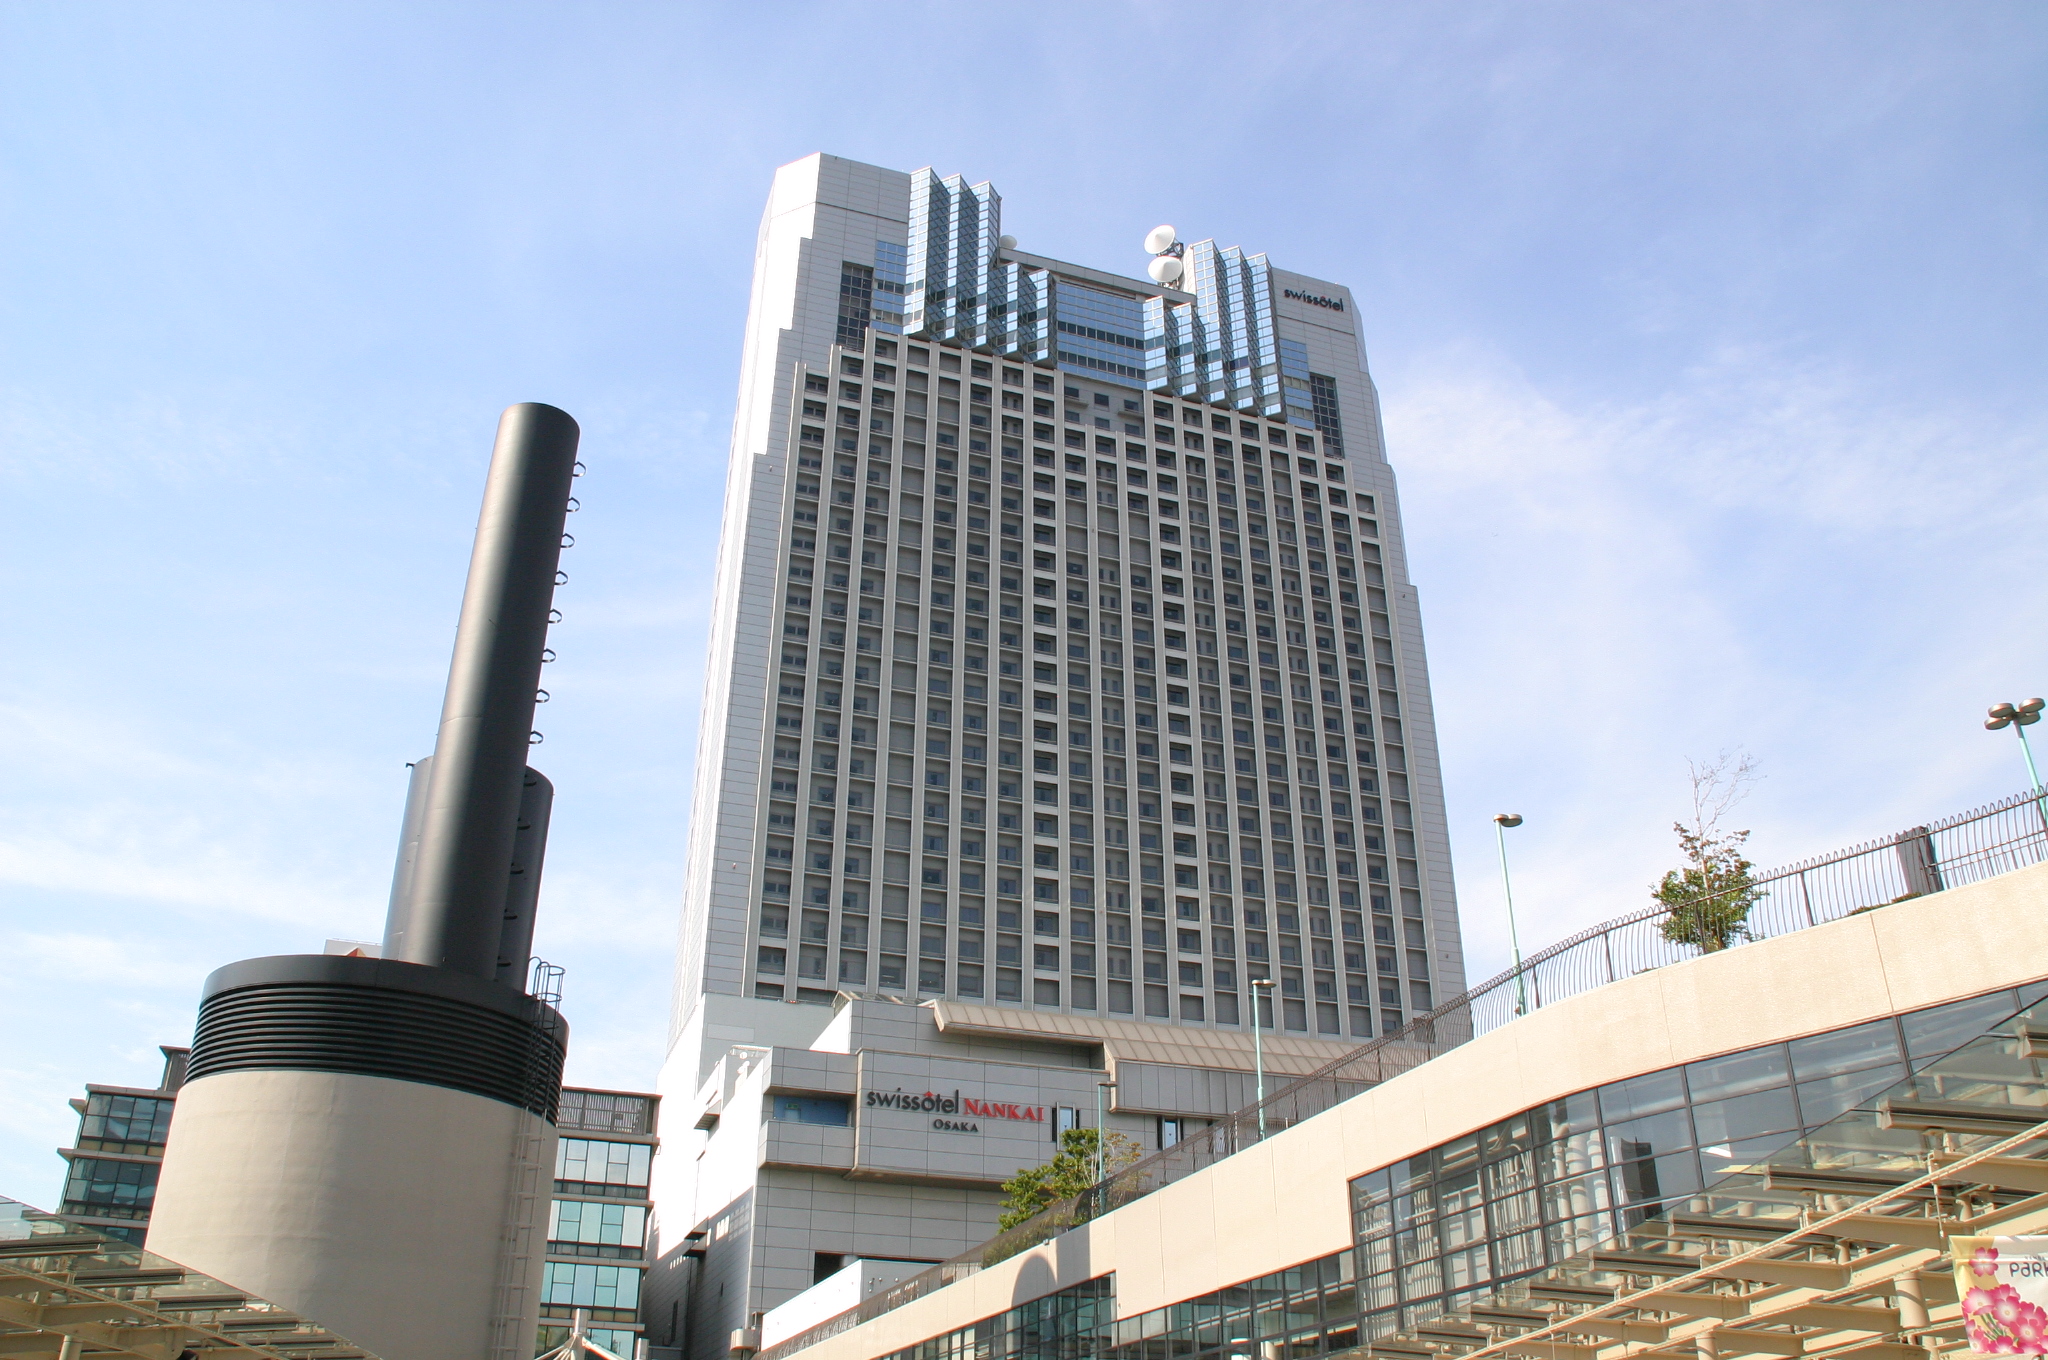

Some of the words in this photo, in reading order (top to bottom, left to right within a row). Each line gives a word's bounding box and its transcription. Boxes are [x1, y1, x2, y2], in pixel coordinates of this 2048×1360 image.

[1284, 288, 1344, 312] swissôtel
[866, 1087, 959, 1114] swissôtel
[963, 1098, 1044, 1121] NANKAI
[933, 1118, 978, 1132] OSAKA
